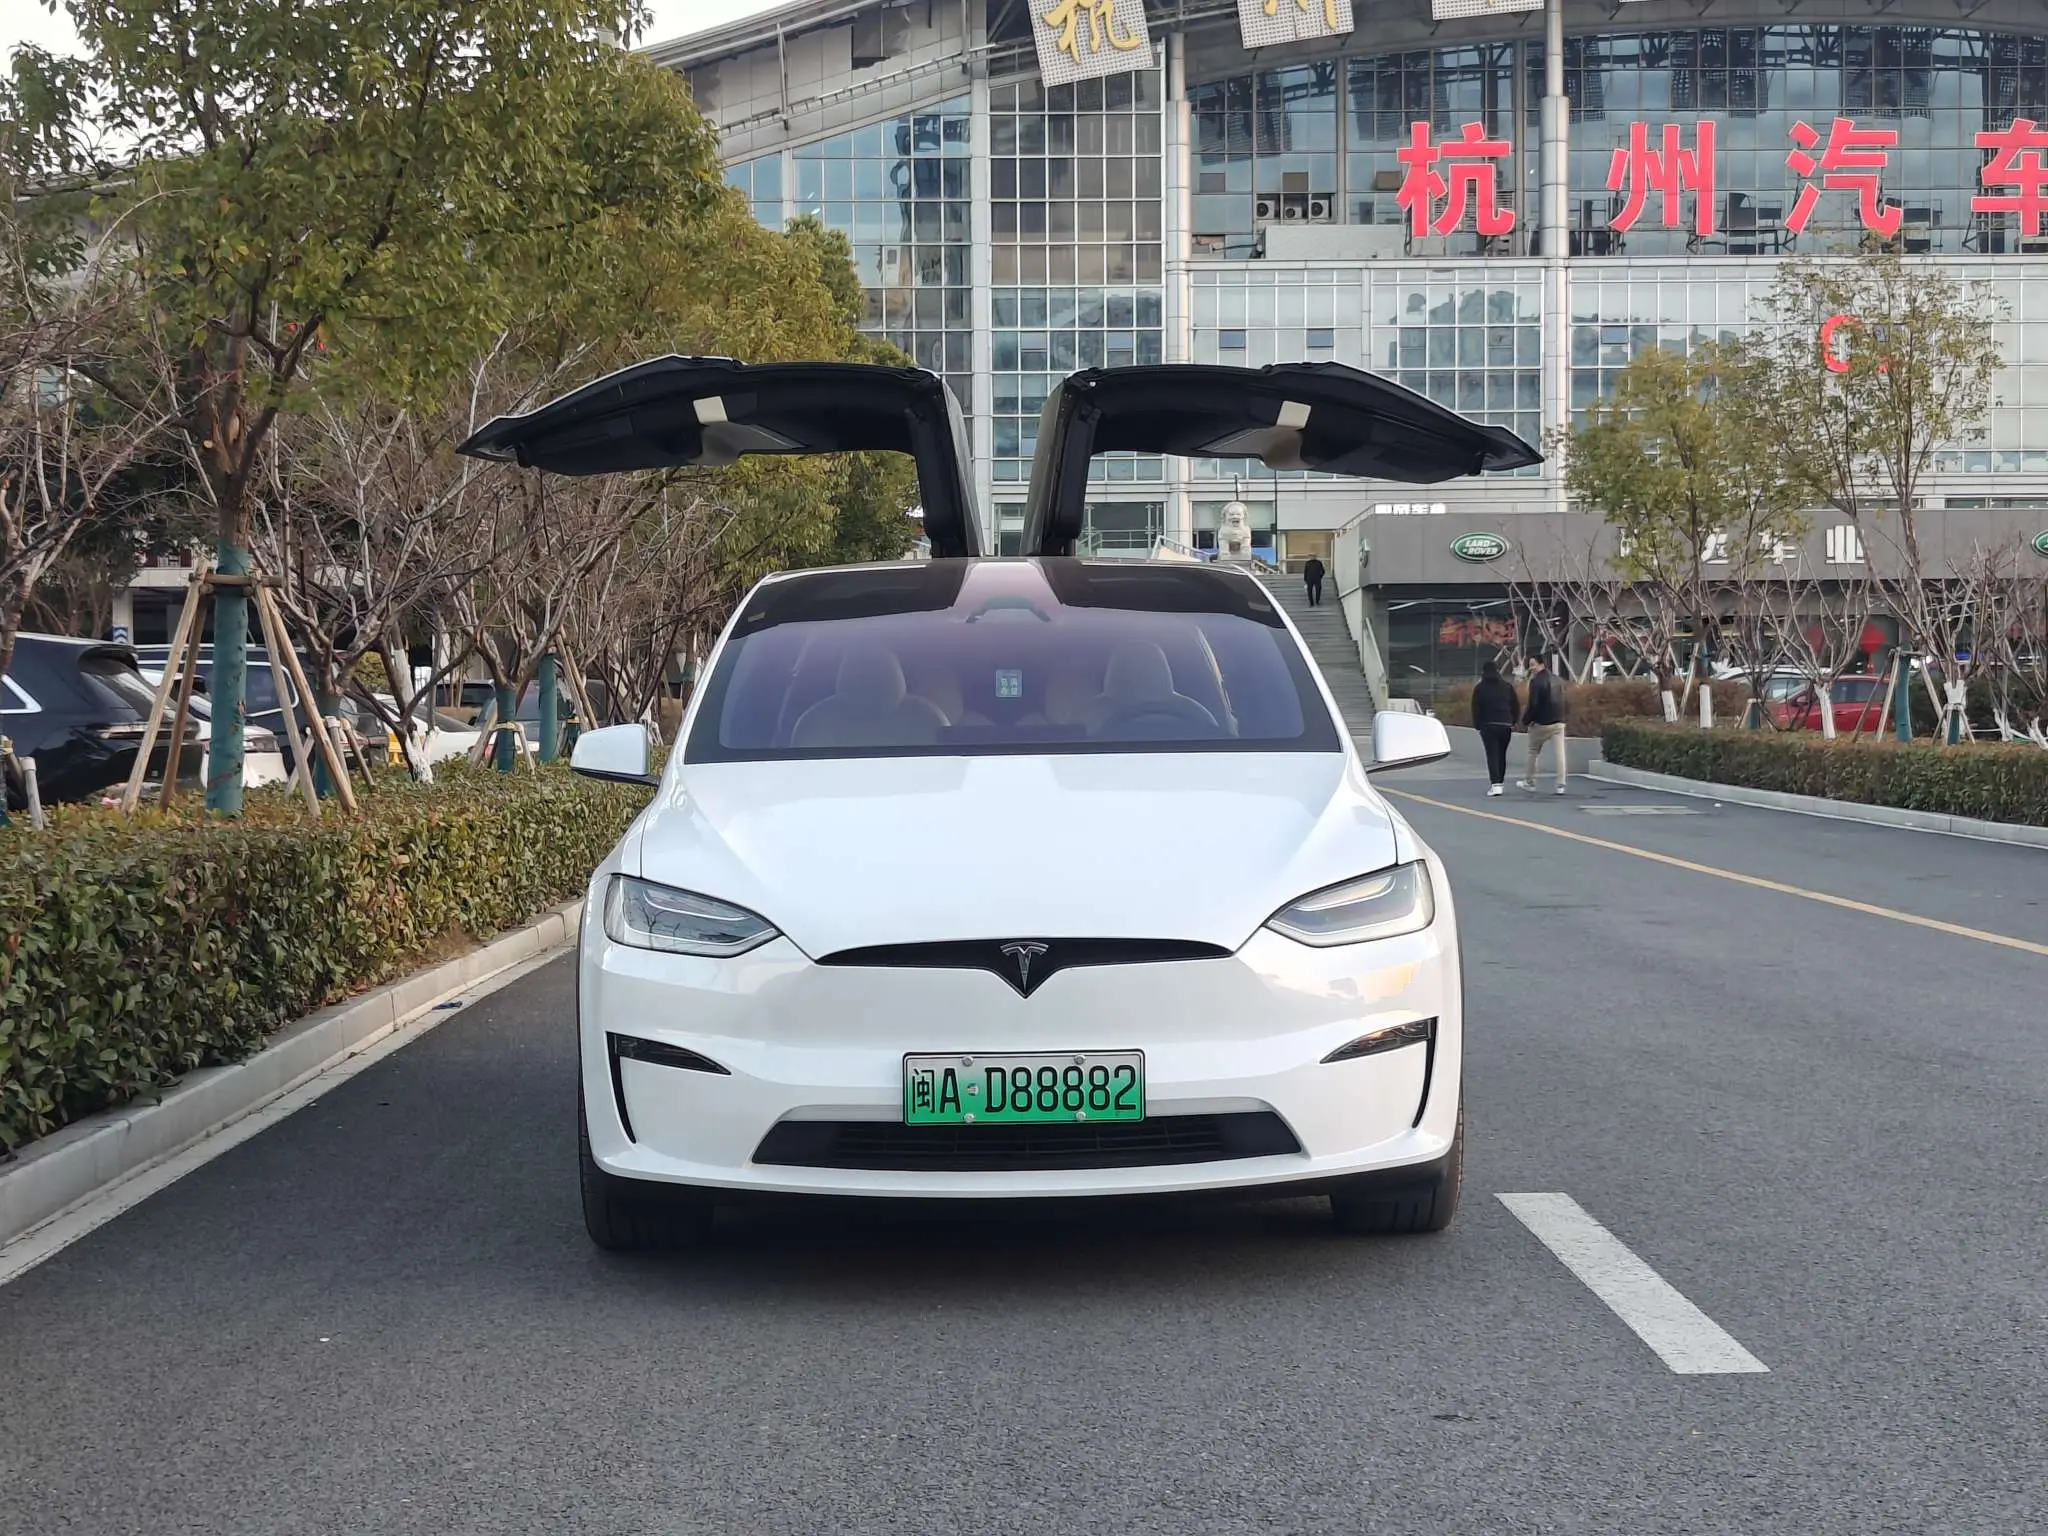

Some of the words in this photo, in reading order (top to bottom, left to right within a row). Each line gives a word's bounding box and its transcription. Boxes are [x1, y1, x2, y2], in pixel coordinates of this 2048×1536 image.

[1465, 539, 1491, 548] LAND
[1467, 547, 1498, 555] ROVER
[984, 1064, 1137, 1113] D88882
